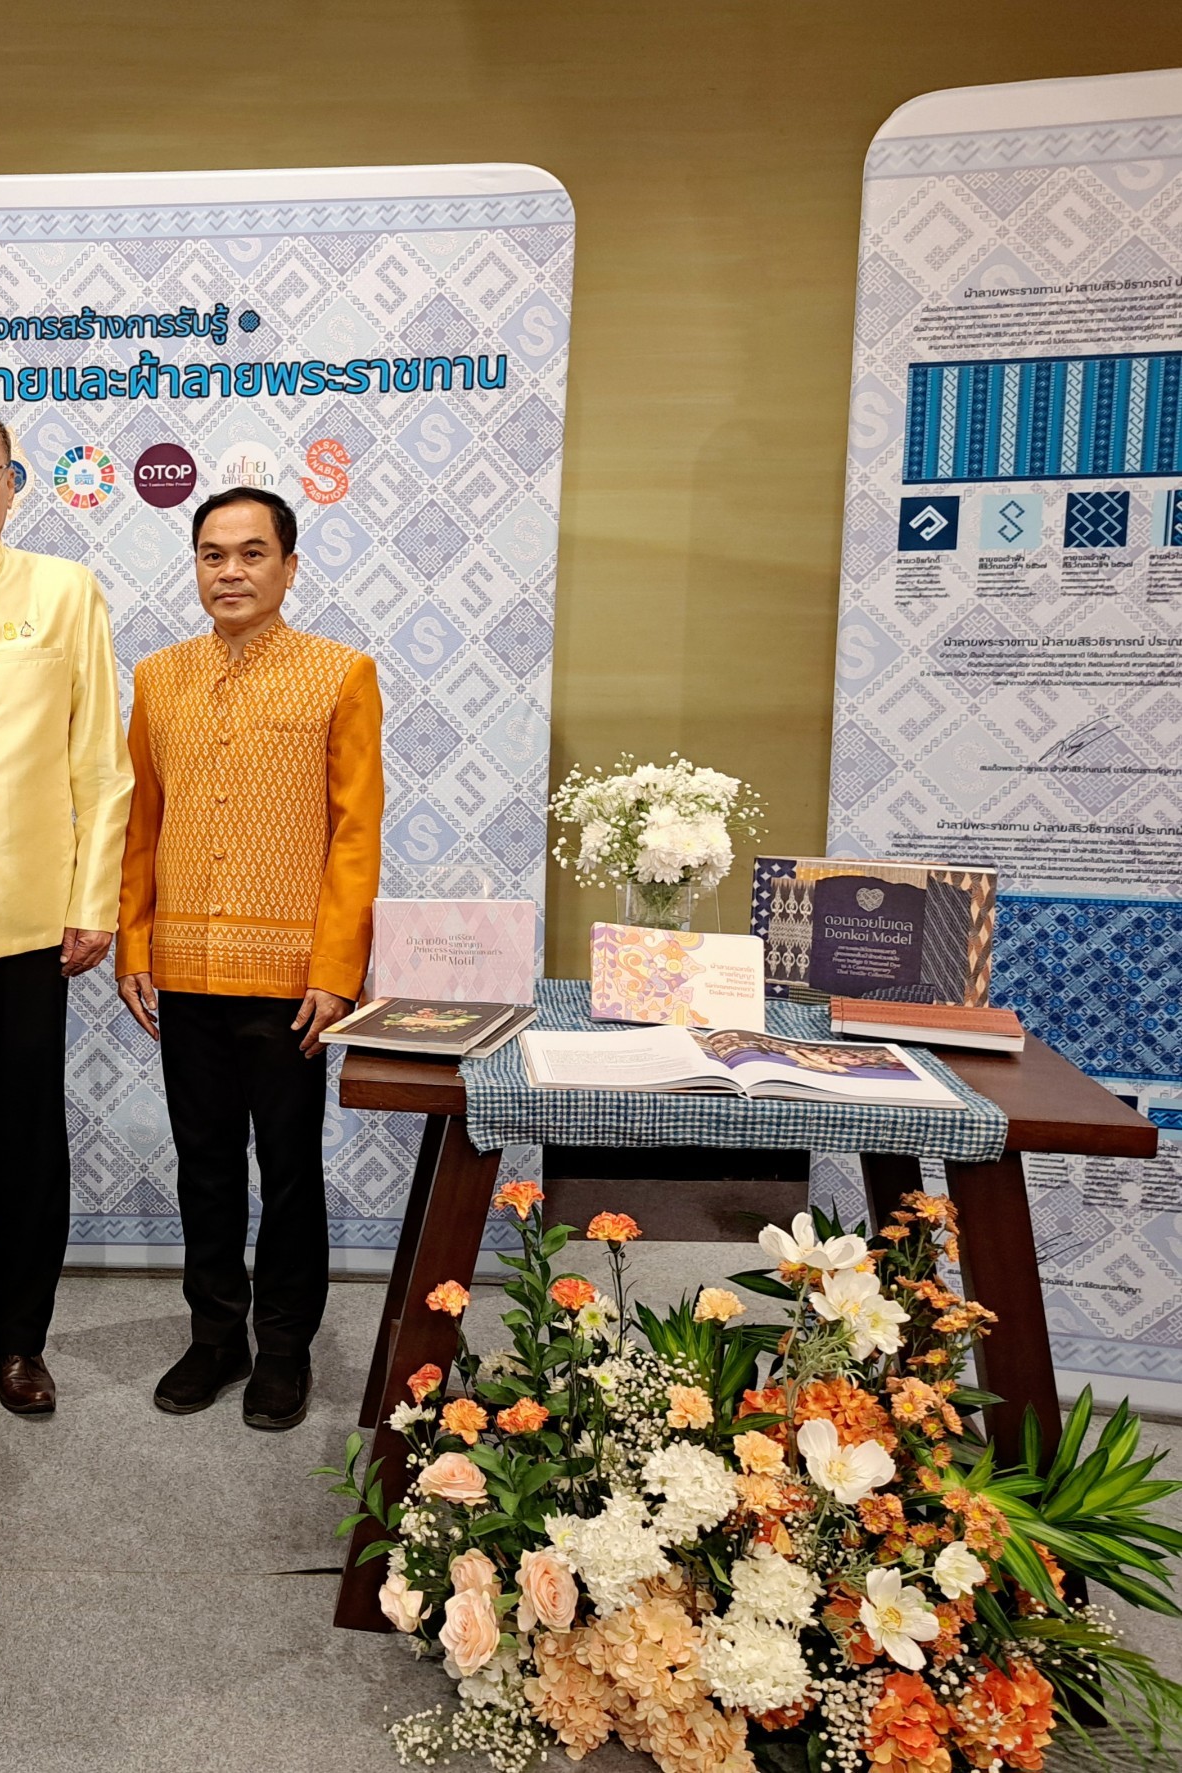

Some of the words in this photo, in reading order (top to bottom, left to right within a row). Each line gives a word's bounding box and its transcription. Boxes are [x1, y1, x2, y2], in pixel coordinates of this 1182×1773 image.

[139, 464, 192, 480] OTOP
[824, 915, 913, 931] ดอนกอยโมเดล
[824, 927, 869, 942] Donkoi
[872, 931, 912, 945] Model
